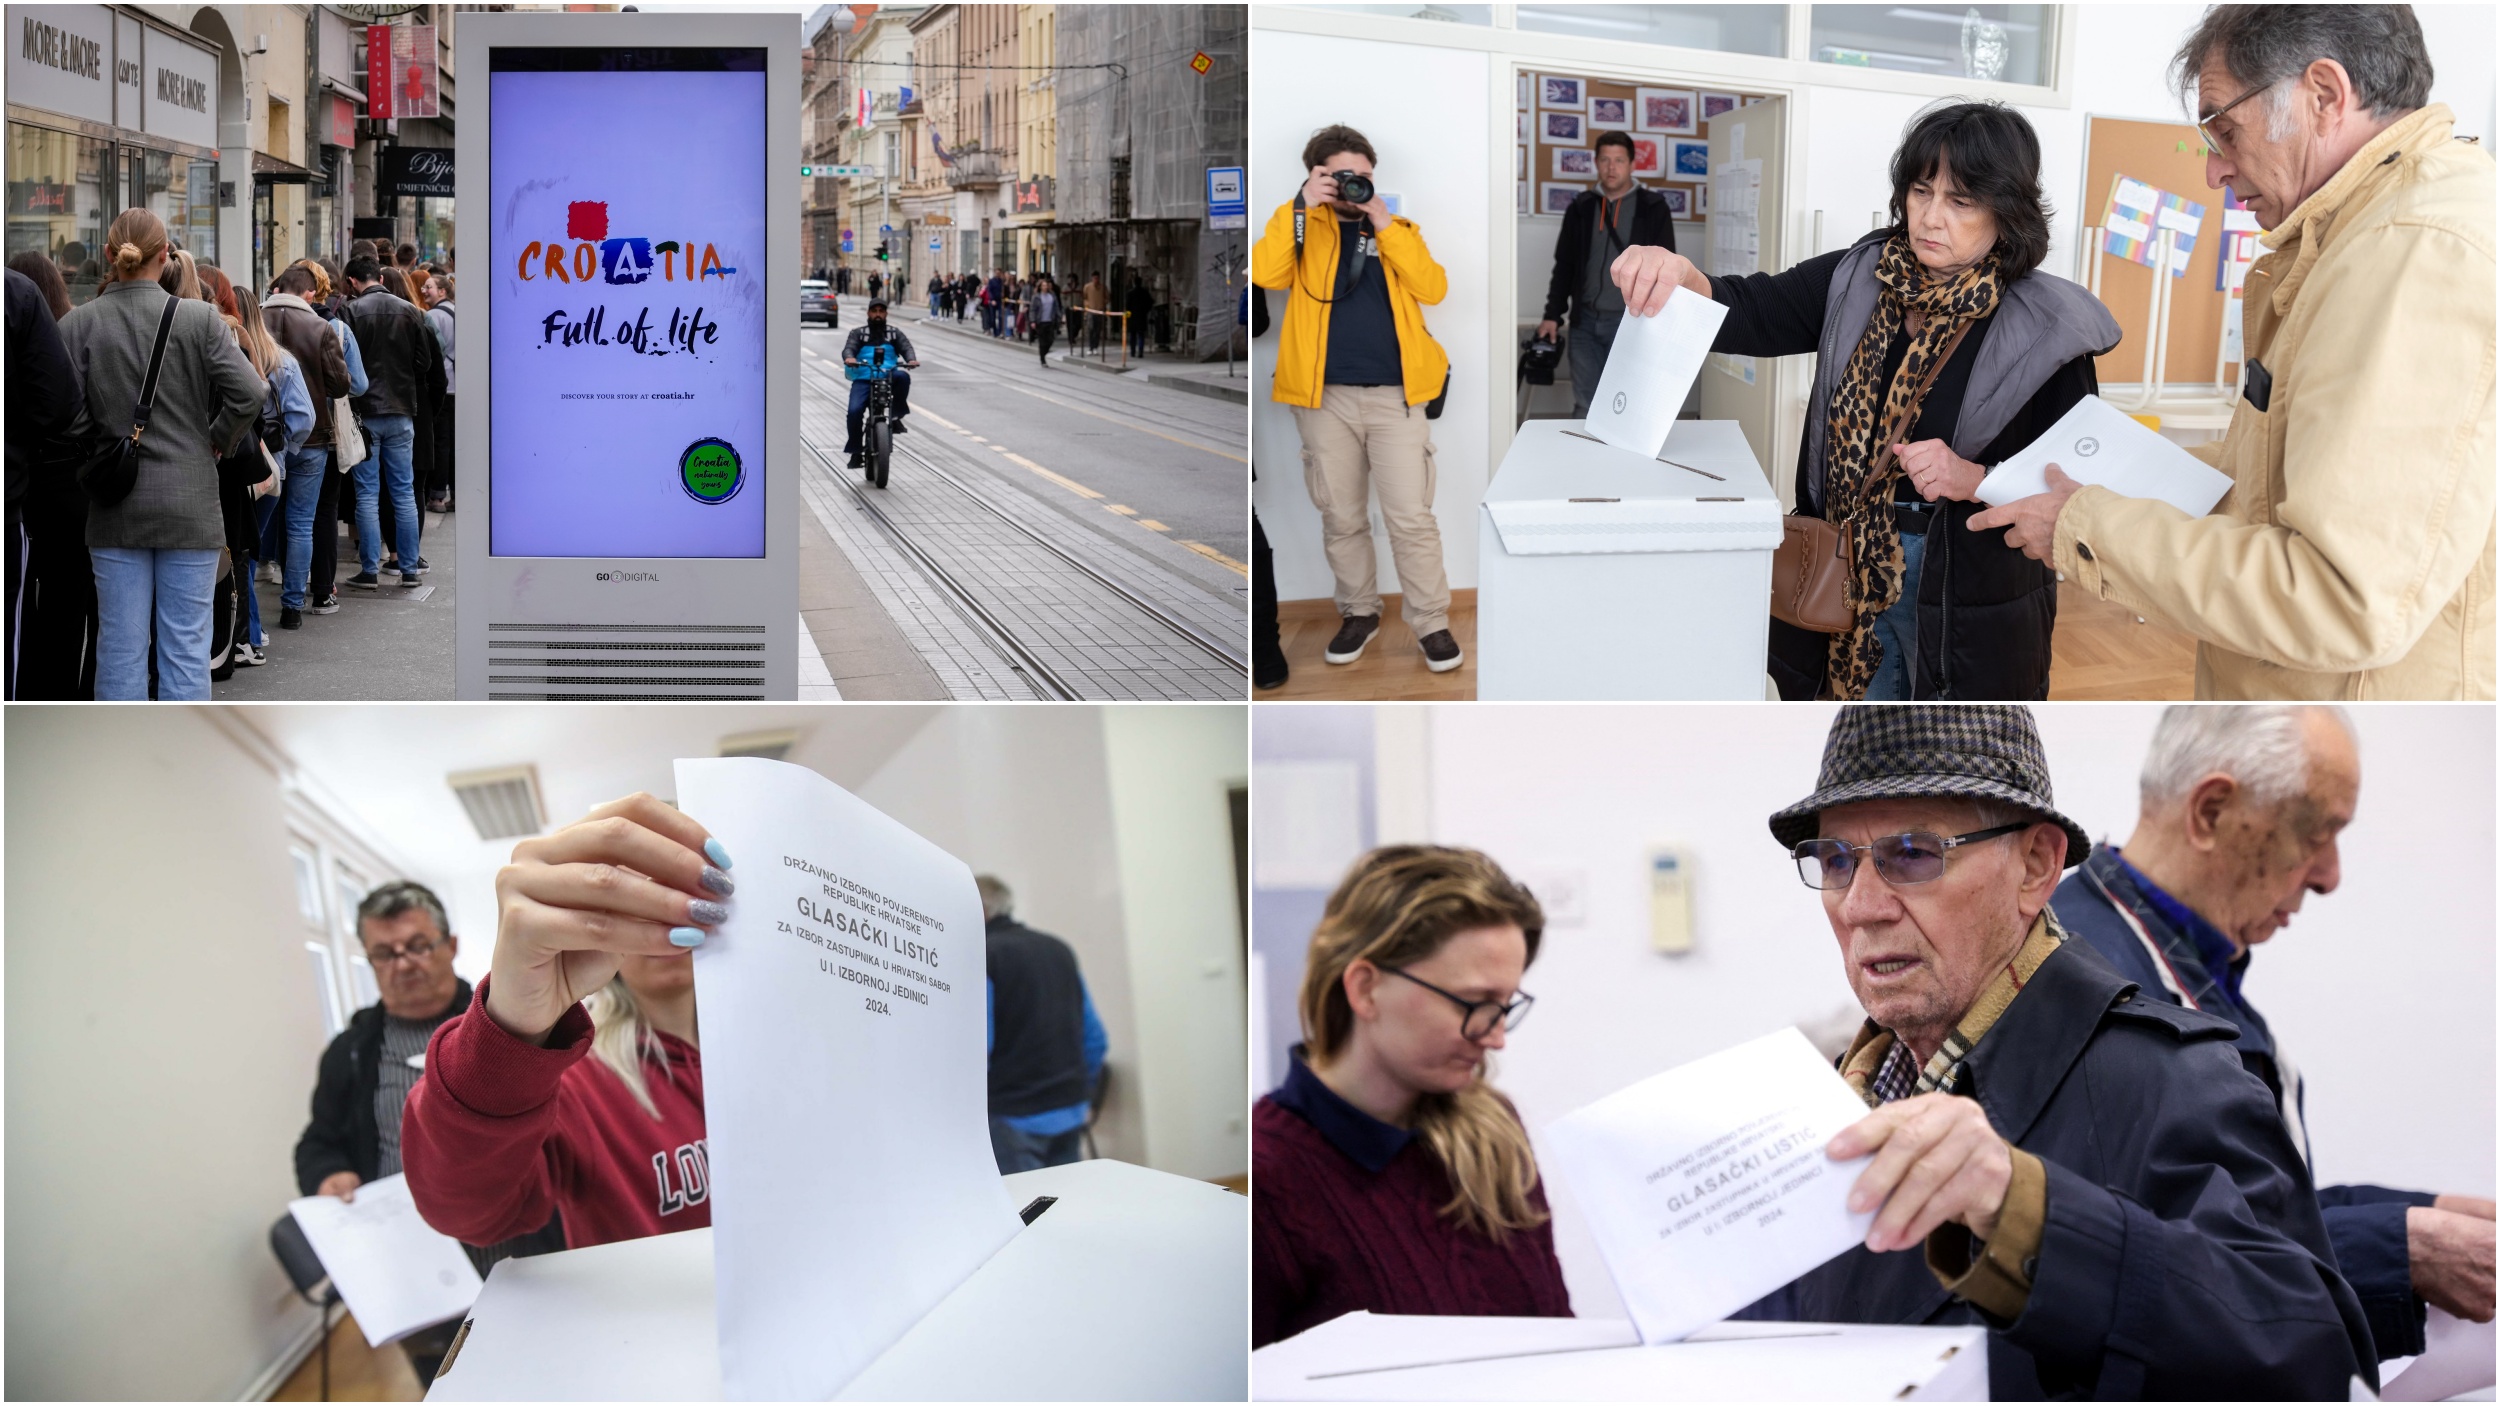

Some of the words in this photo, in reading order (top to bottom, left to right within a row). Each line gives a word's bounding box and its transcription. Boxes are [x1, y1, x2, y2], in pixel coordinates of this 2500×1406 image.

[23, 17, 58, 68] MORE
[60, 30, 68, 72] &
[69, 34, 100, 81] MORE
[157, 67, 180, 106] MORE
[180, 75, 186, 108] &
[186, 78, 206, 113] MORE
[409, 151, 455, 183] Bijo
[1296, 214, 1304, 243] SONY
[518, 240, 737, 284] CROATIA
[541, 305, 608, 346] Full
[616, 307, 654, 354] of
[668, 307, 719, 354] life
[651, 391, 695, 400] croatia.hr
[693, 454, 731, 468] Croatia
[783, 855, 837, 884] DRŽAVNO
[840, 877, 881, 903] IZBORNO
[883, 896, 944, 932] POVJERENSTVO
[823, 884, 876, 916] REPUBLIKE
[878, 907, 922, 935] HRVATSKE
[797, 896, 888, 948] GLASAČKI
[893, 935, 939, 968] LISTIĆ
[777, 921, 793, 934] ZA
[796, 926, 824, 947] IZBOR
[826, 939, 880, 967] ZASTUPNIKA
[882, 959, 889, 970] U
[891, 962, 927, 984] HRVATSKI
[928, 977, 951, 993] SABOR
[819, 958, 827, 972] U
[830, 962, 836, 976] I.
[838, 965, 890, 993] IZBORNOJ
[892, 985, 928, 1006] JEDINICI
[865, 997, 891, 1016] 2024.
[1666, 1154, 1762, 1213] GLASAČKI
[1762, 1125, 1817, 1161] LISTIĆ
